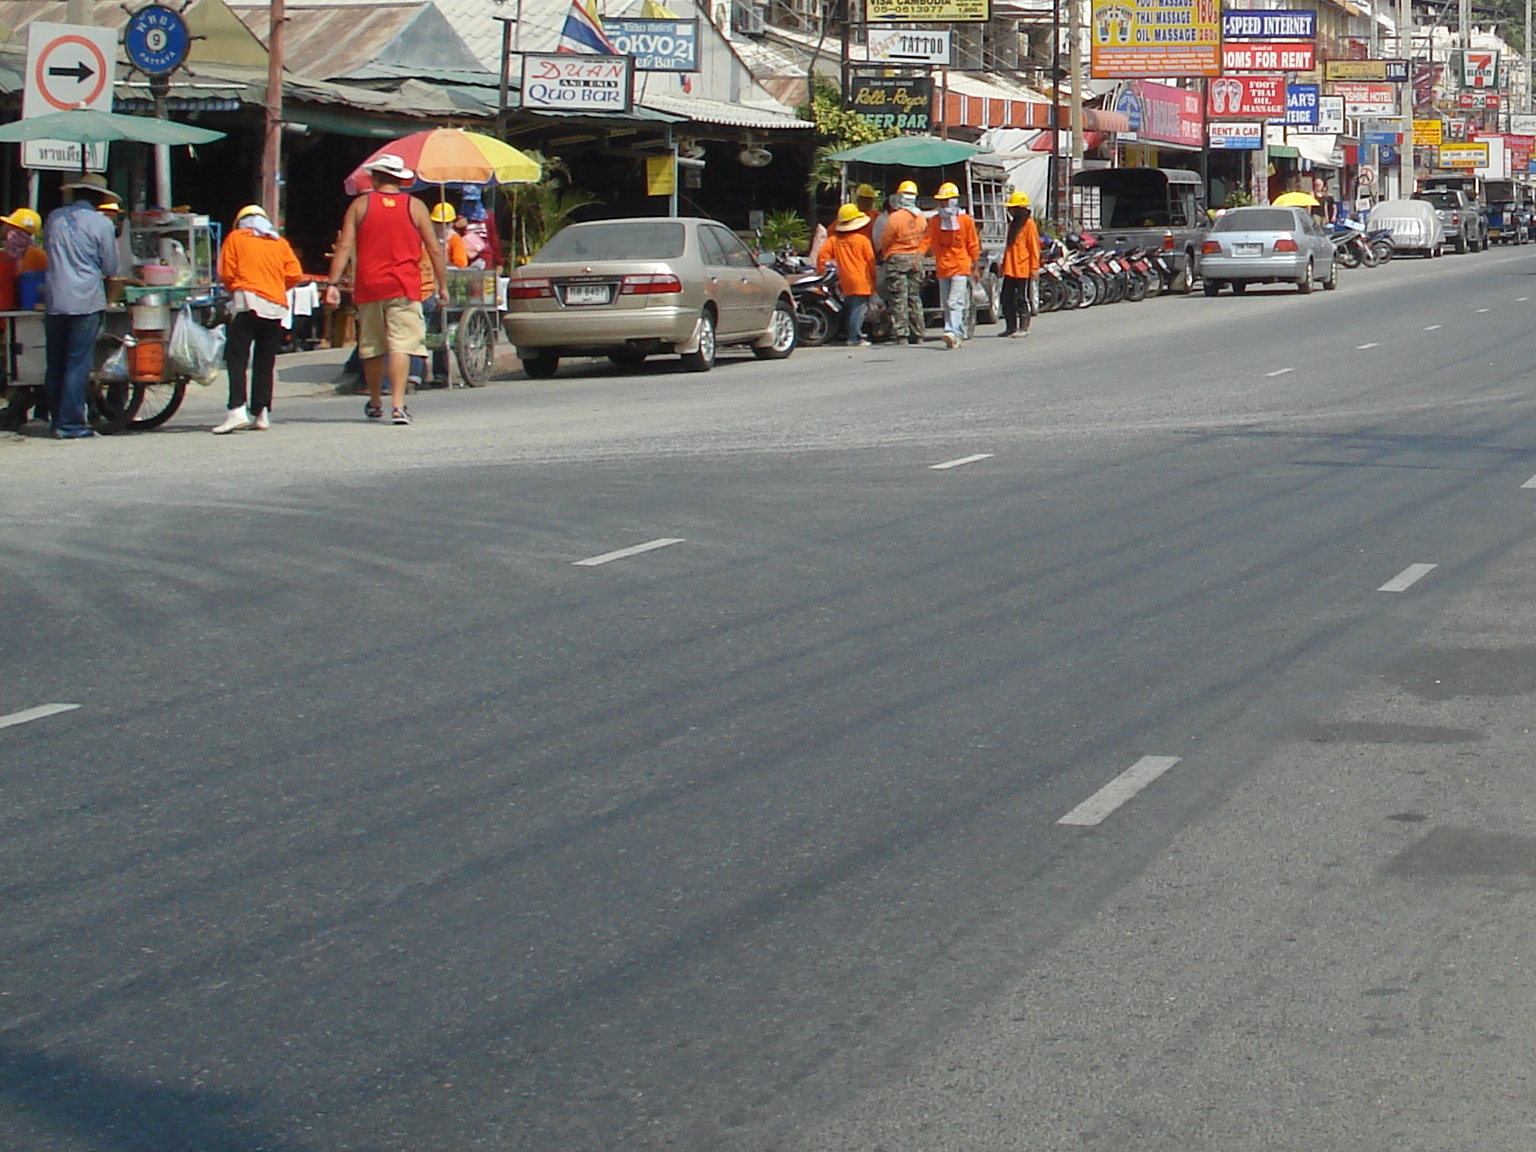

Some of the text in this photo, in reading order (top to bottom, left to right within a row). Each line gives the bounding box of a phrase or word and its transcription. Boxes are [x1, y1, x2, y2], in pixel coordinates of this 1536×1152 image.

[1136, 11, 1191, 24] THAI MASSAGE
[1263, 16, 1312, 35] INTERNET
[152, 33, 161, 46] 9
[1136, 29, 1151, 42] OIL
[1154, 28, 1197, 42] MASSAGE
[673, 39, 695, 62] 21
[900, 35, 943, 55] TATTOO
[139, 51, 176, 65] PATTAYA
[1255, 51, 1278, 68] FOR
[1281, 51, 1312, 68] RENT
[531, 61, 624, 80] DUAN
[1468, 54, 1492, 87] 7
[1249, 81, 1278, 89] FOOT
[855, 87, 929, 113] Rolls-Royce
[1249, 89, 1277, 97] THAI
[1370, 91, 1392, 102] HOTEL
[1253, 97, 1273, 105] OIL
[1473, 97, 1485, 106] 24
[1242, 105, 1284, 113] MASSAGE
[896, 113, 928, 129] BAR
[1211, 127, 1259, 136] RENT A CAR
